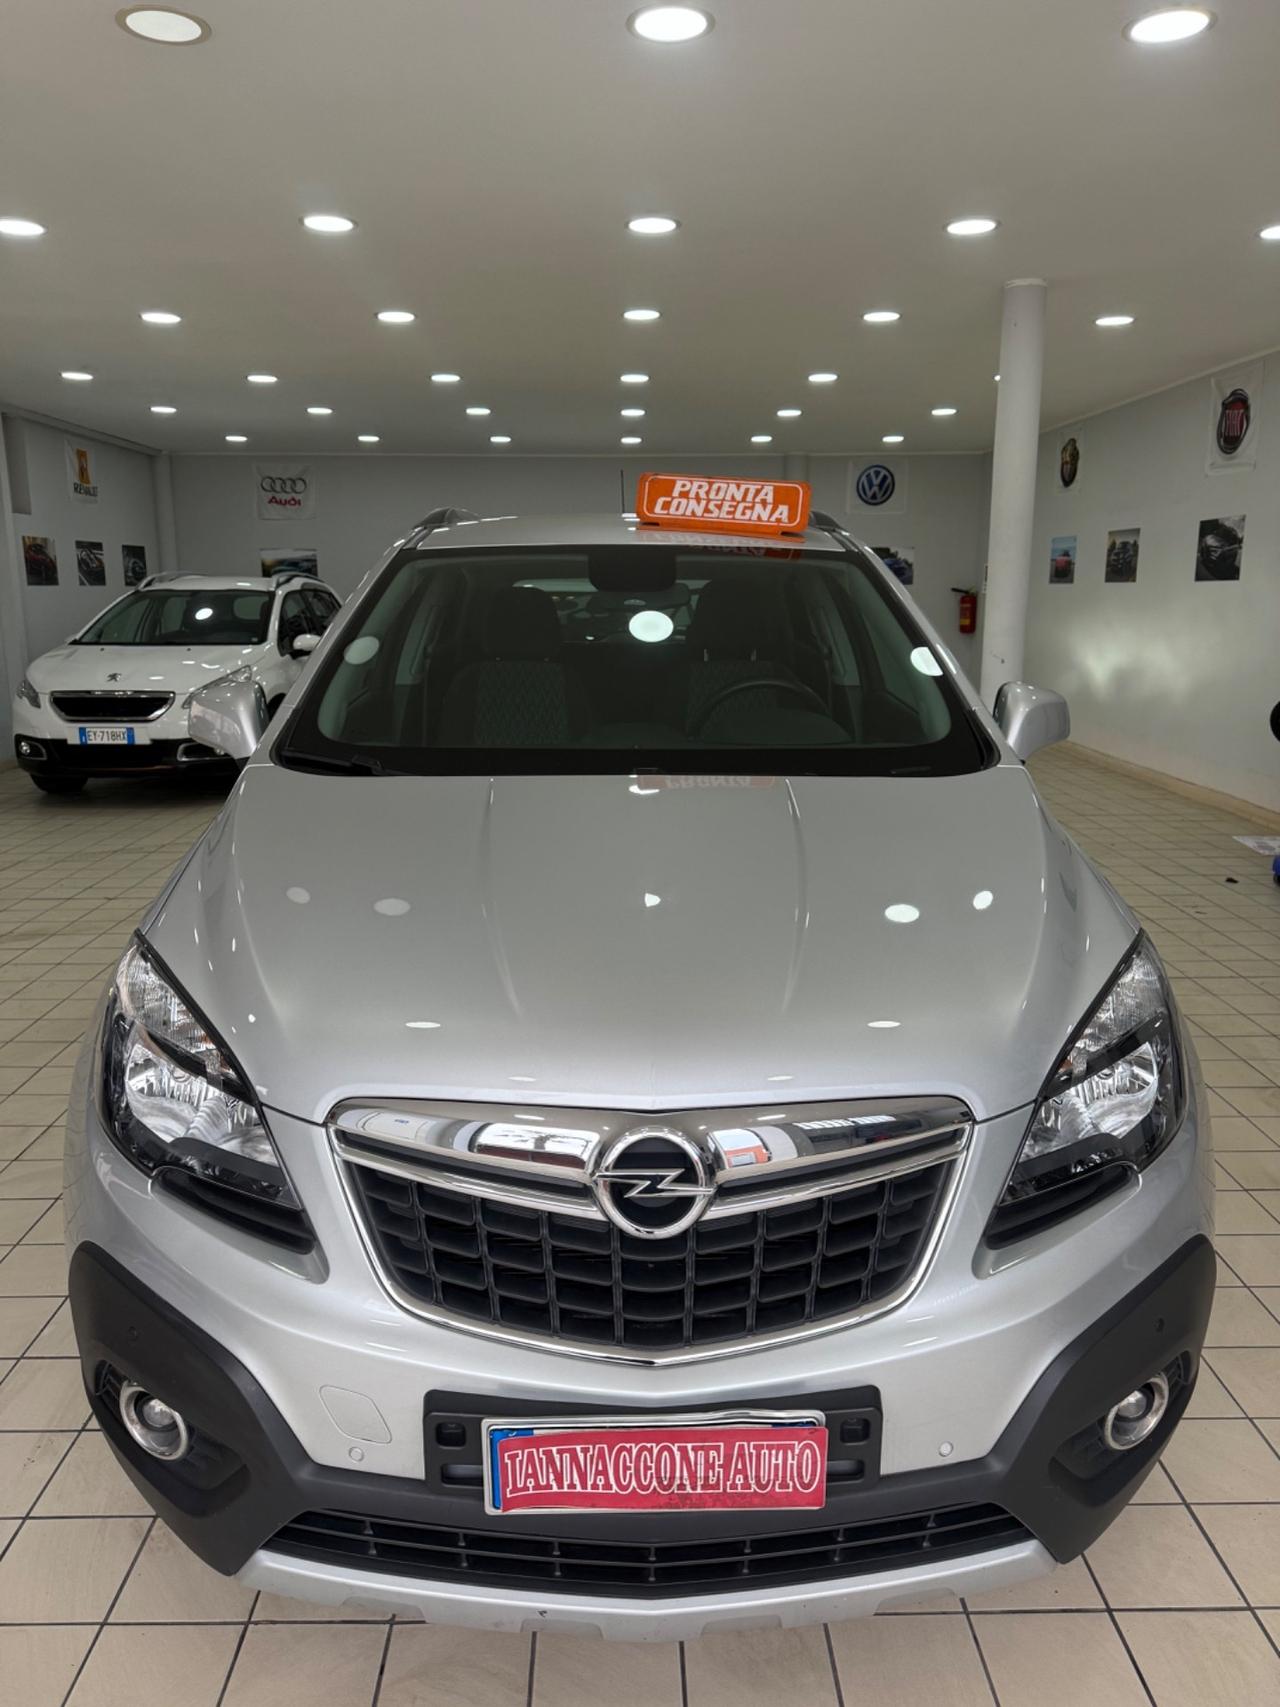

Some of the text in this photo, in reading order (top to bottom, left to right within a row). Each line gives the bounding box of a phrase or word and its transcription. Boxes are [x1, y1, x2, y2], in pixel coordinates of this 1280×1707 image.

[268, 495, 302, 507] Audi
[672, 479, 775, 503] PRONTA
[653, 497, 790, 523] CONSEGNA
[504, 1440, 822, 1498] IANNACCONE AUTO
